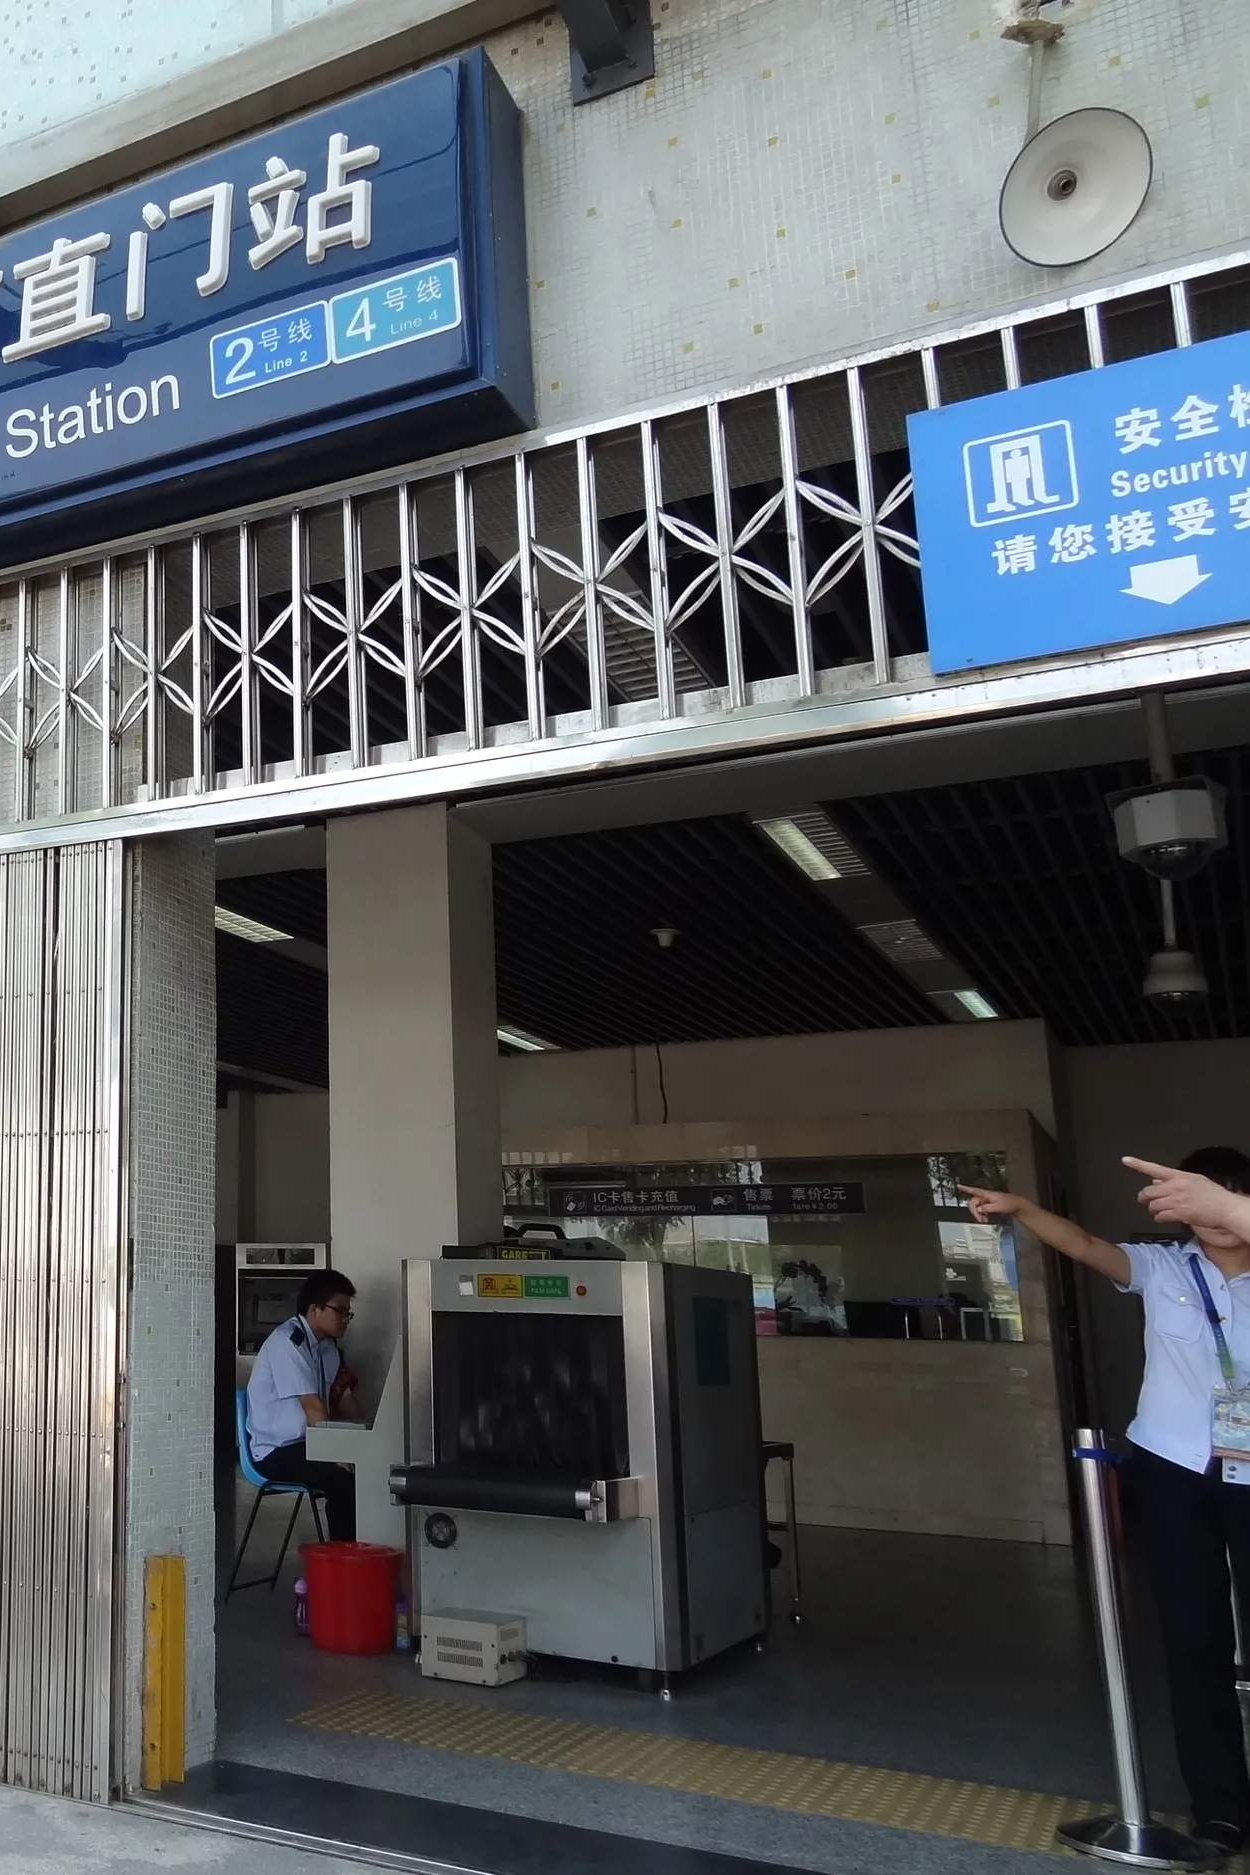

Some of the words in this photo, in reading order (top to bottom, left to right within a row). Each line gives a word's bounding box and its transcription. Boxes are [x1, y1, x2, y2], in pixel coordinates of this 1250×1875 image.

[344, 275, 443, 343] 4号线
[390, 315, 423, 336] Line
[428, 309, 439, 322] 4
[224, 317, 314, 386] 2号线
[264, 357, 293, 374] Line
[299, 350, 308, 363] 2
[6, 373, 181, 461] Station
[1110, 450, 1247, 498] Security
[593, 1190, 679, 1204] IC卡售卡充值
[743, 1187, 774, 1201] 售票
[791, 1186, 847, 1201] 票价2元
[601, 1204, 618, 1212] Card
[618, 1204, 644, 1214] Vending
